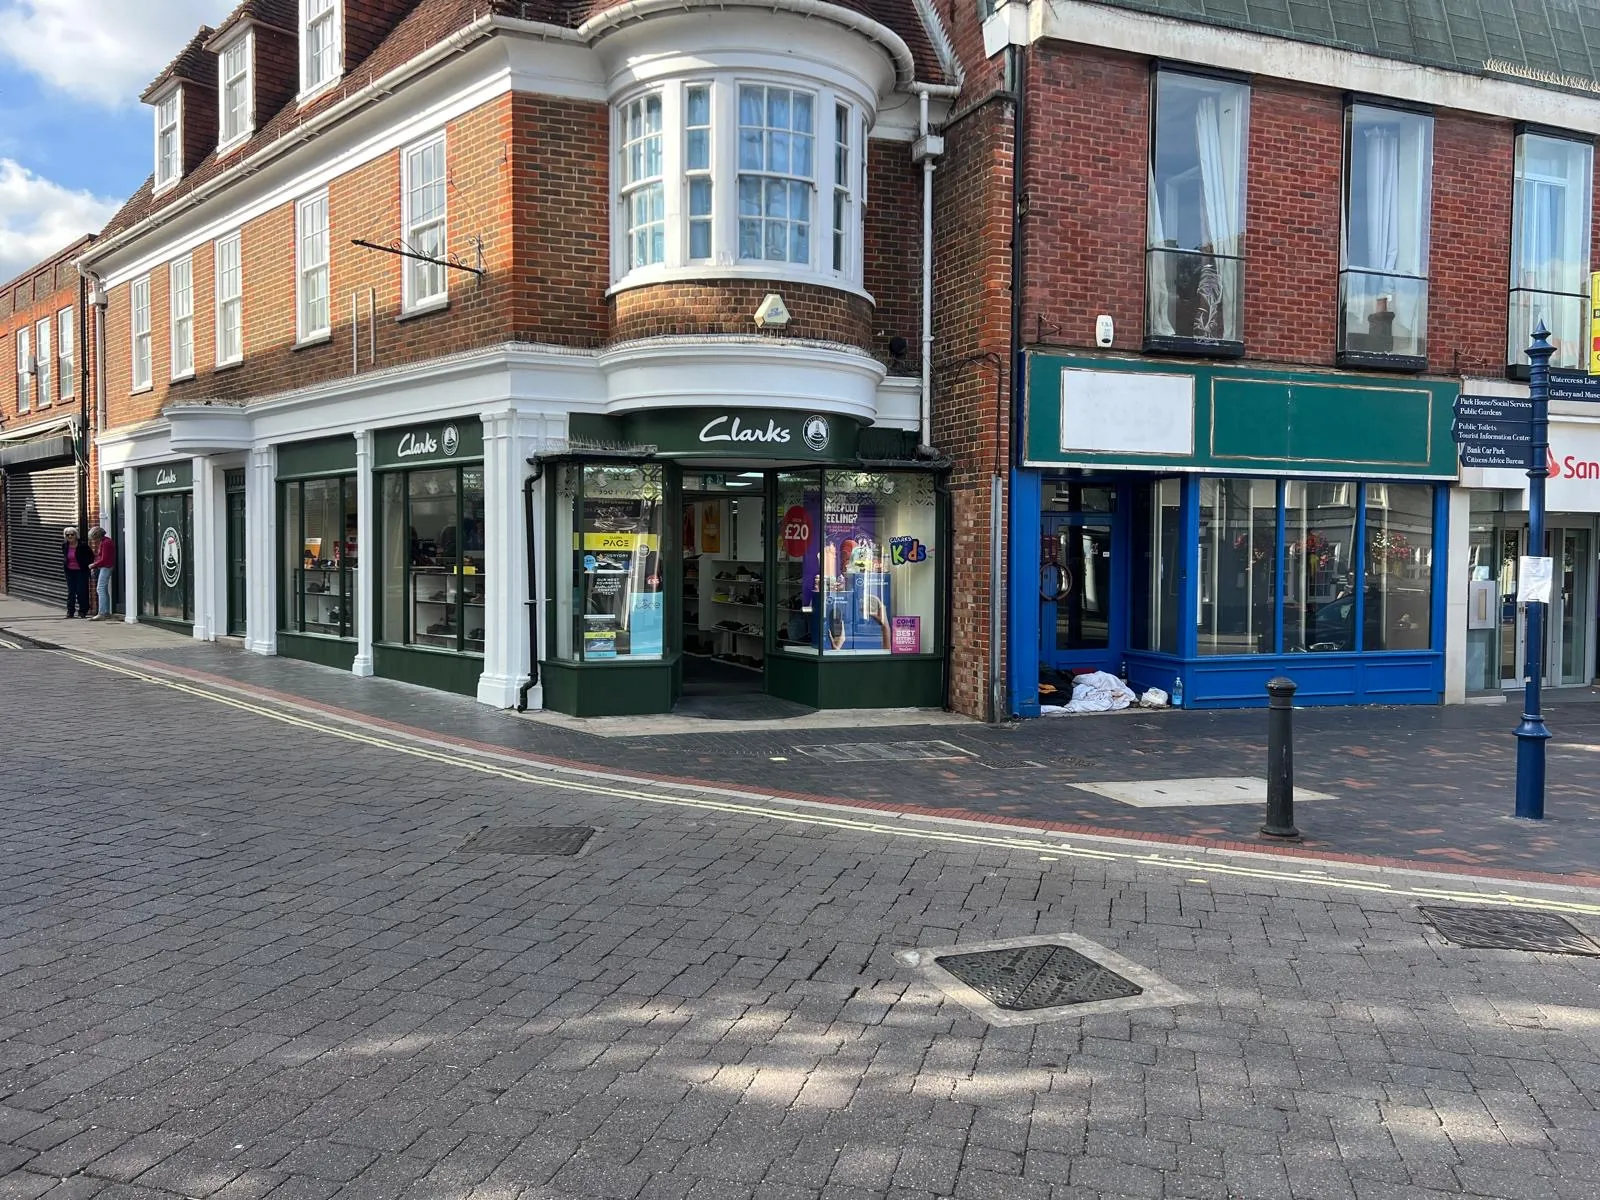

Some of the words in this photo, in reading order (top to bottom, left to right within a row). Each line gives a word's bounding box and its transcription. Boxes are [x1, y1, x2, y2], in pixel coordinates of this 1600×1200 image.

[1550, 375, 1583, 384] Watercress
[1584, 377, 1598, 385] Line
[1550, 389, 1572, 399] Gallery
[1460, 397, 1474, 405] Park
[1474, 398, 1510, 407] House/Social
[1460, 407, 1478, 415] Public
[1478, 408, 1502, 416] Gardens
[699, 415, 791, 443] Clarks
[1458, 422, 1477, 431] Public
[1477, 423, 1497, 431] Toilets
[1458, 431, 1479, 439] Tourist
[1479, 432, 1512, 440] Information
[397, 432, 438, 457] Clarks
[1466, 446, 1481, 454] Bank
[1481, 446, 1492, 454] Car
[1492, 447, 1506, 455] Park
[1466, 455, 1488, 463] Citizens
[1488, 456, 1505, 464] Advice
[1505, 457, 1525, 465] Bureau
[156, 468, 177, 486] Clarks
[824, 513, 858, 524] EELING?
[784, 523, 809, 540] £20
